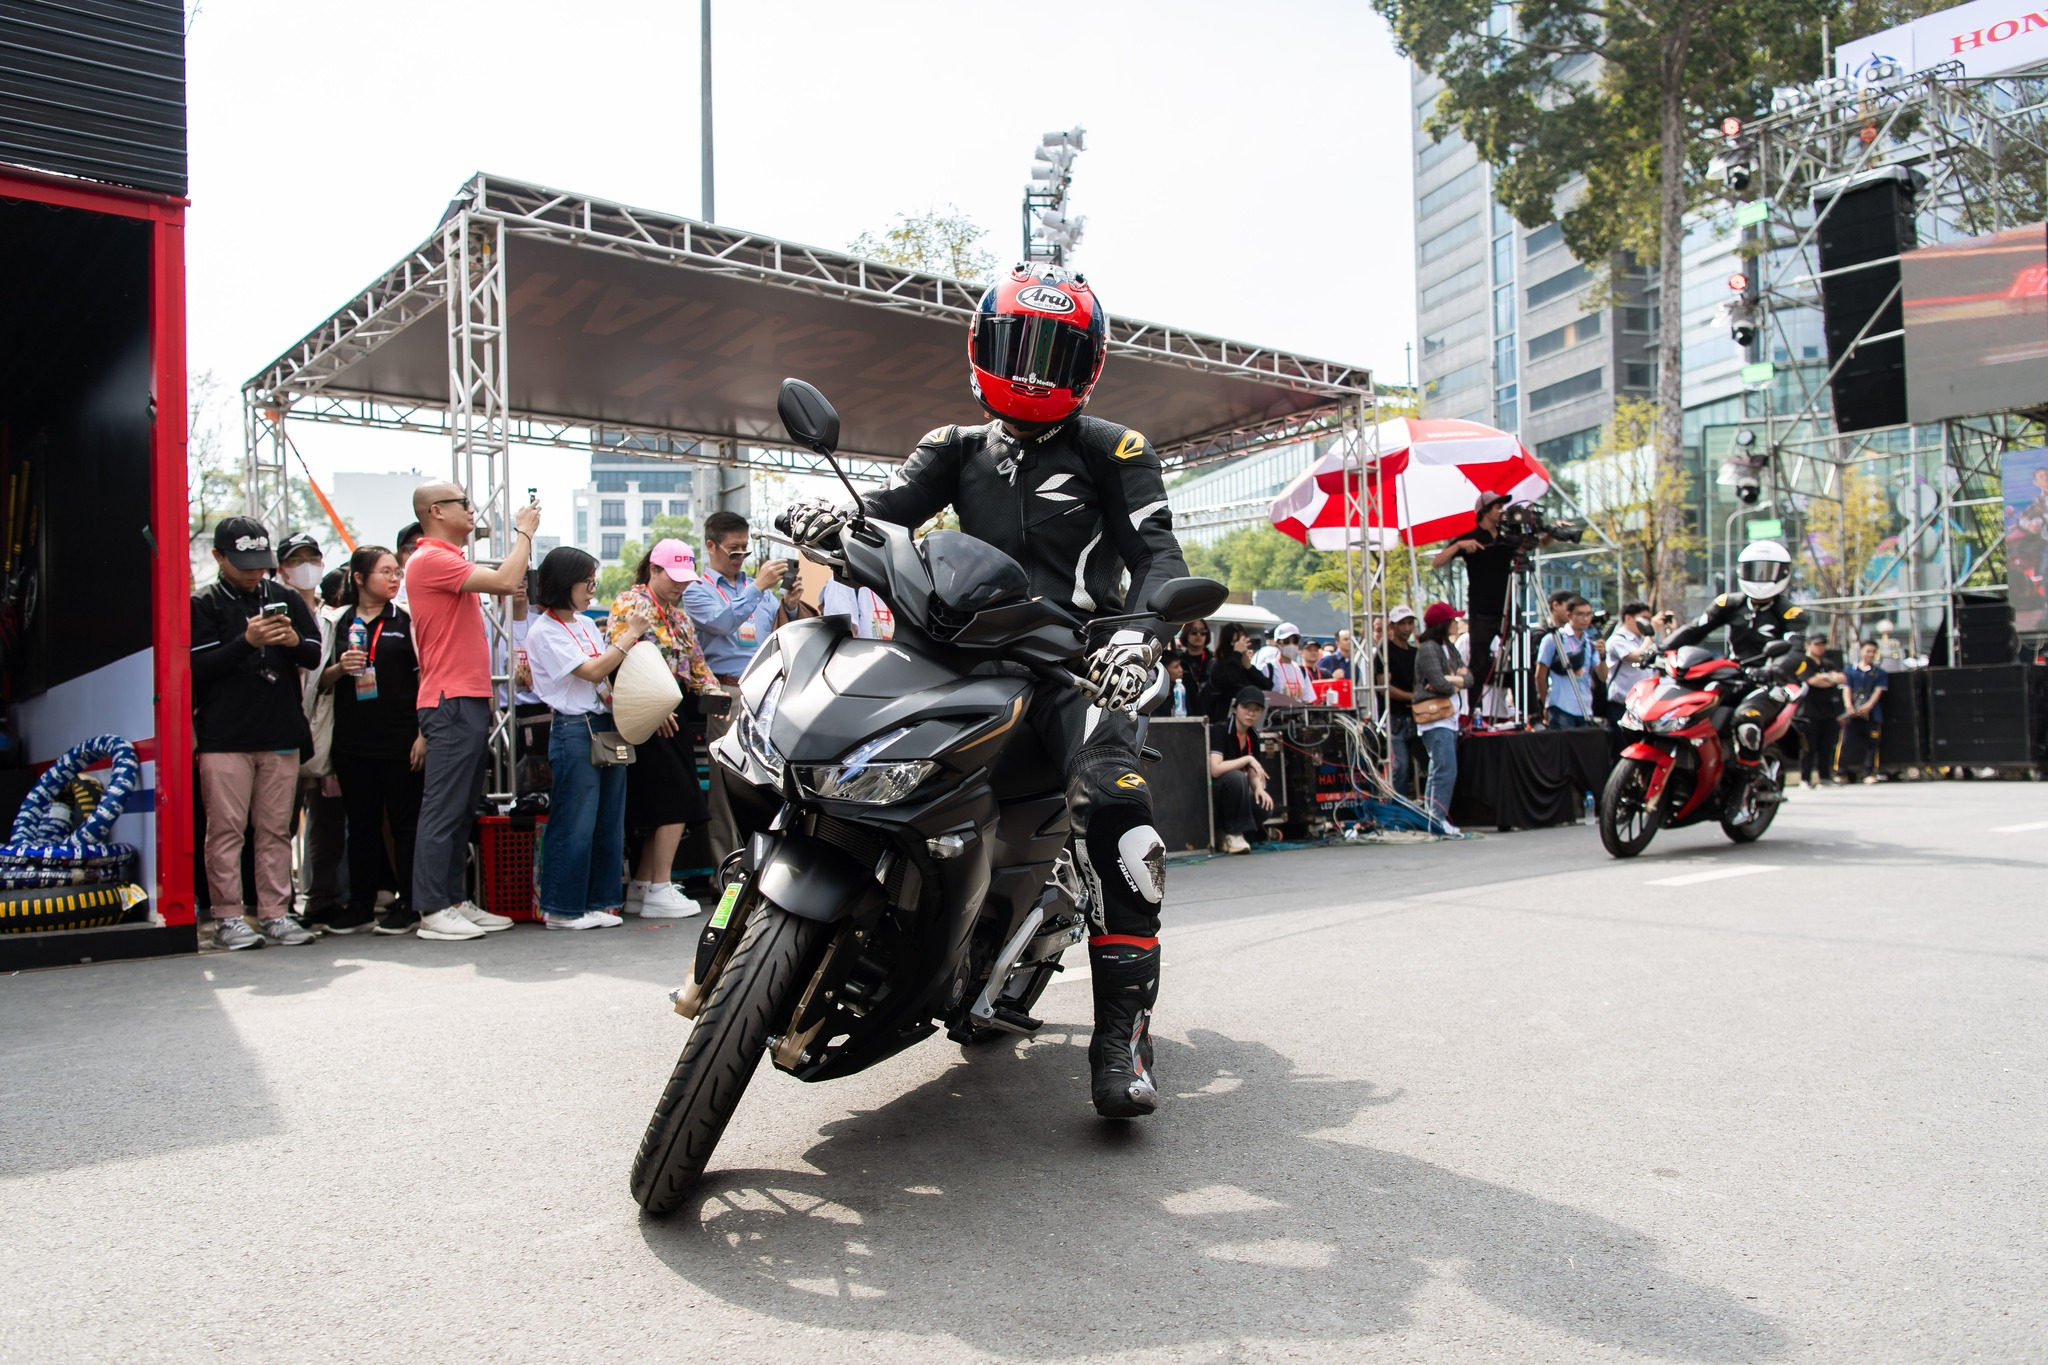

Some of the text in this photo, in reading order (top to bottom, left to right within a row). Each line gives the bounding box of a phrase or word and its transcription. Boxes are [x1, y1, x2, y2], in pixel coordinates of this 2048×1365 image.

[1021, 288, 1069, 307] Arai
[1036, 424, 1064, 444] TAIC
[1320, 801, 1333, 811] LED
[1117, 856, 1139, 893] TAICHI
